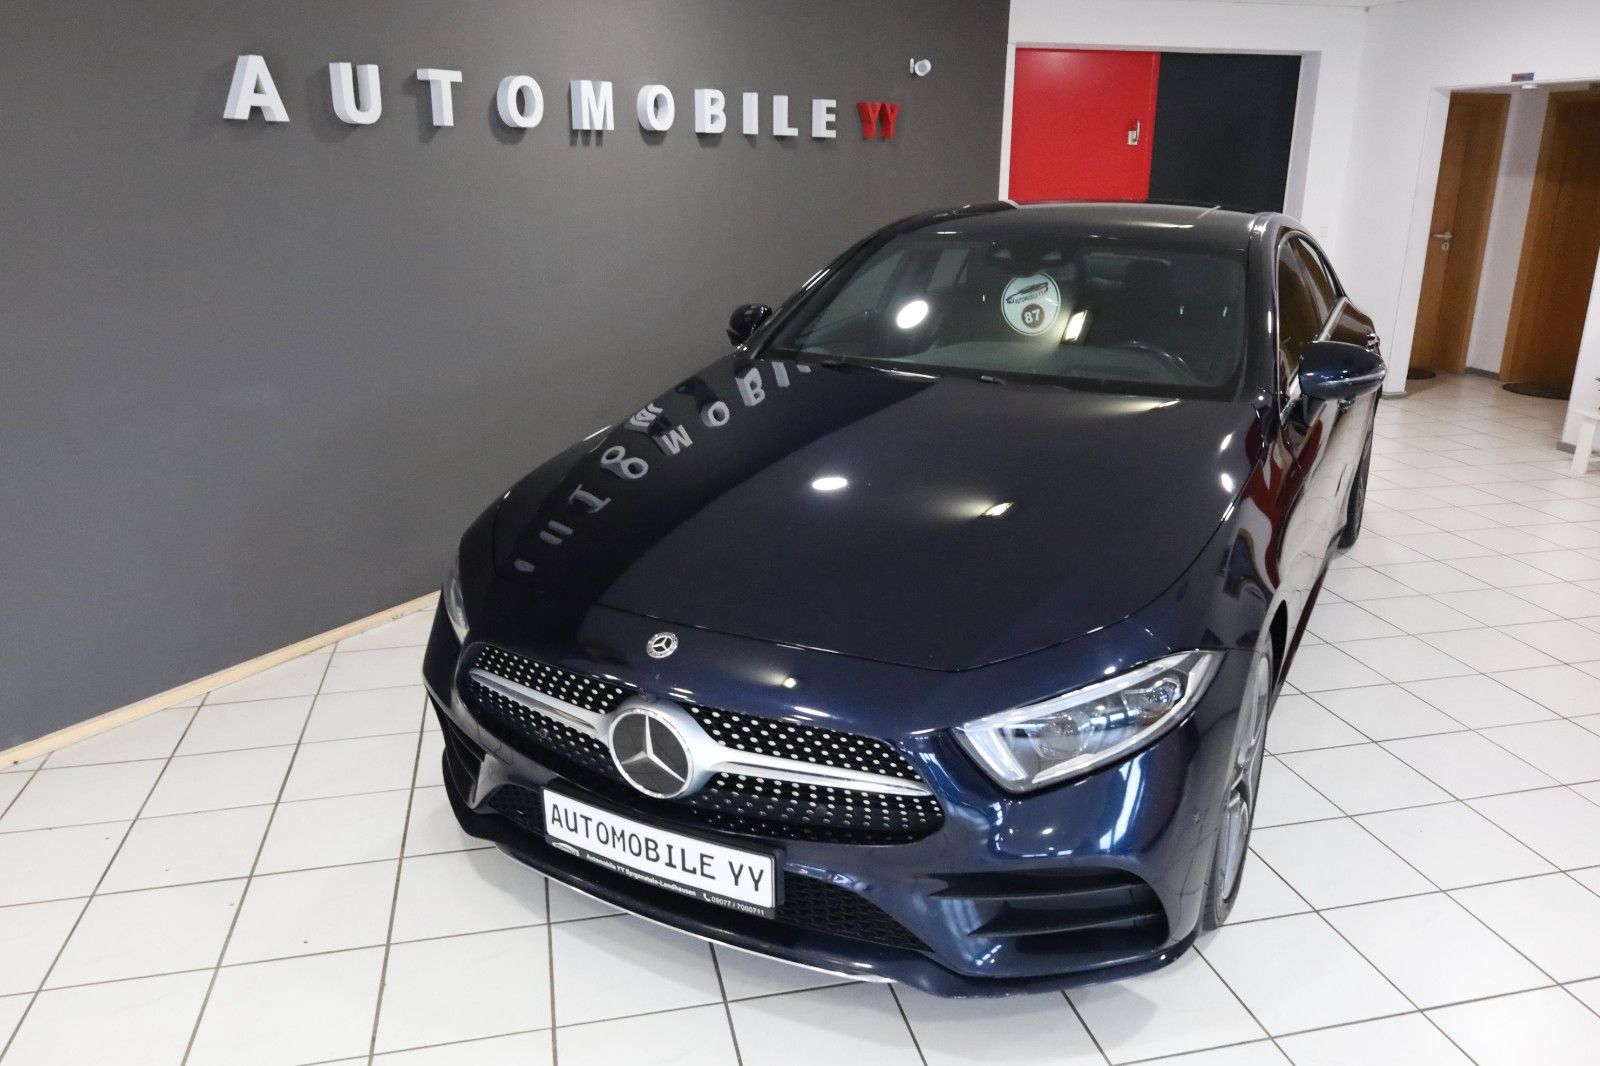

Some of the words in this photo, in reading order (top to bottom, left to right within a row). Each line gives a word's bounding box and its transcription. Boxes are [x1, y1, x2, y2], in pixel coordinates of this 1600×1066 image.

[222, 54, 837, 139] AUTOMOBILE
[856, 101, 899, 139] YY
[1024, 309, 1040, 324] 87
[551, 803, 716, 880] AUTOMOBILE
[728, 860, 764, 892] YY
[586, 853, 617, 870] Automobile
